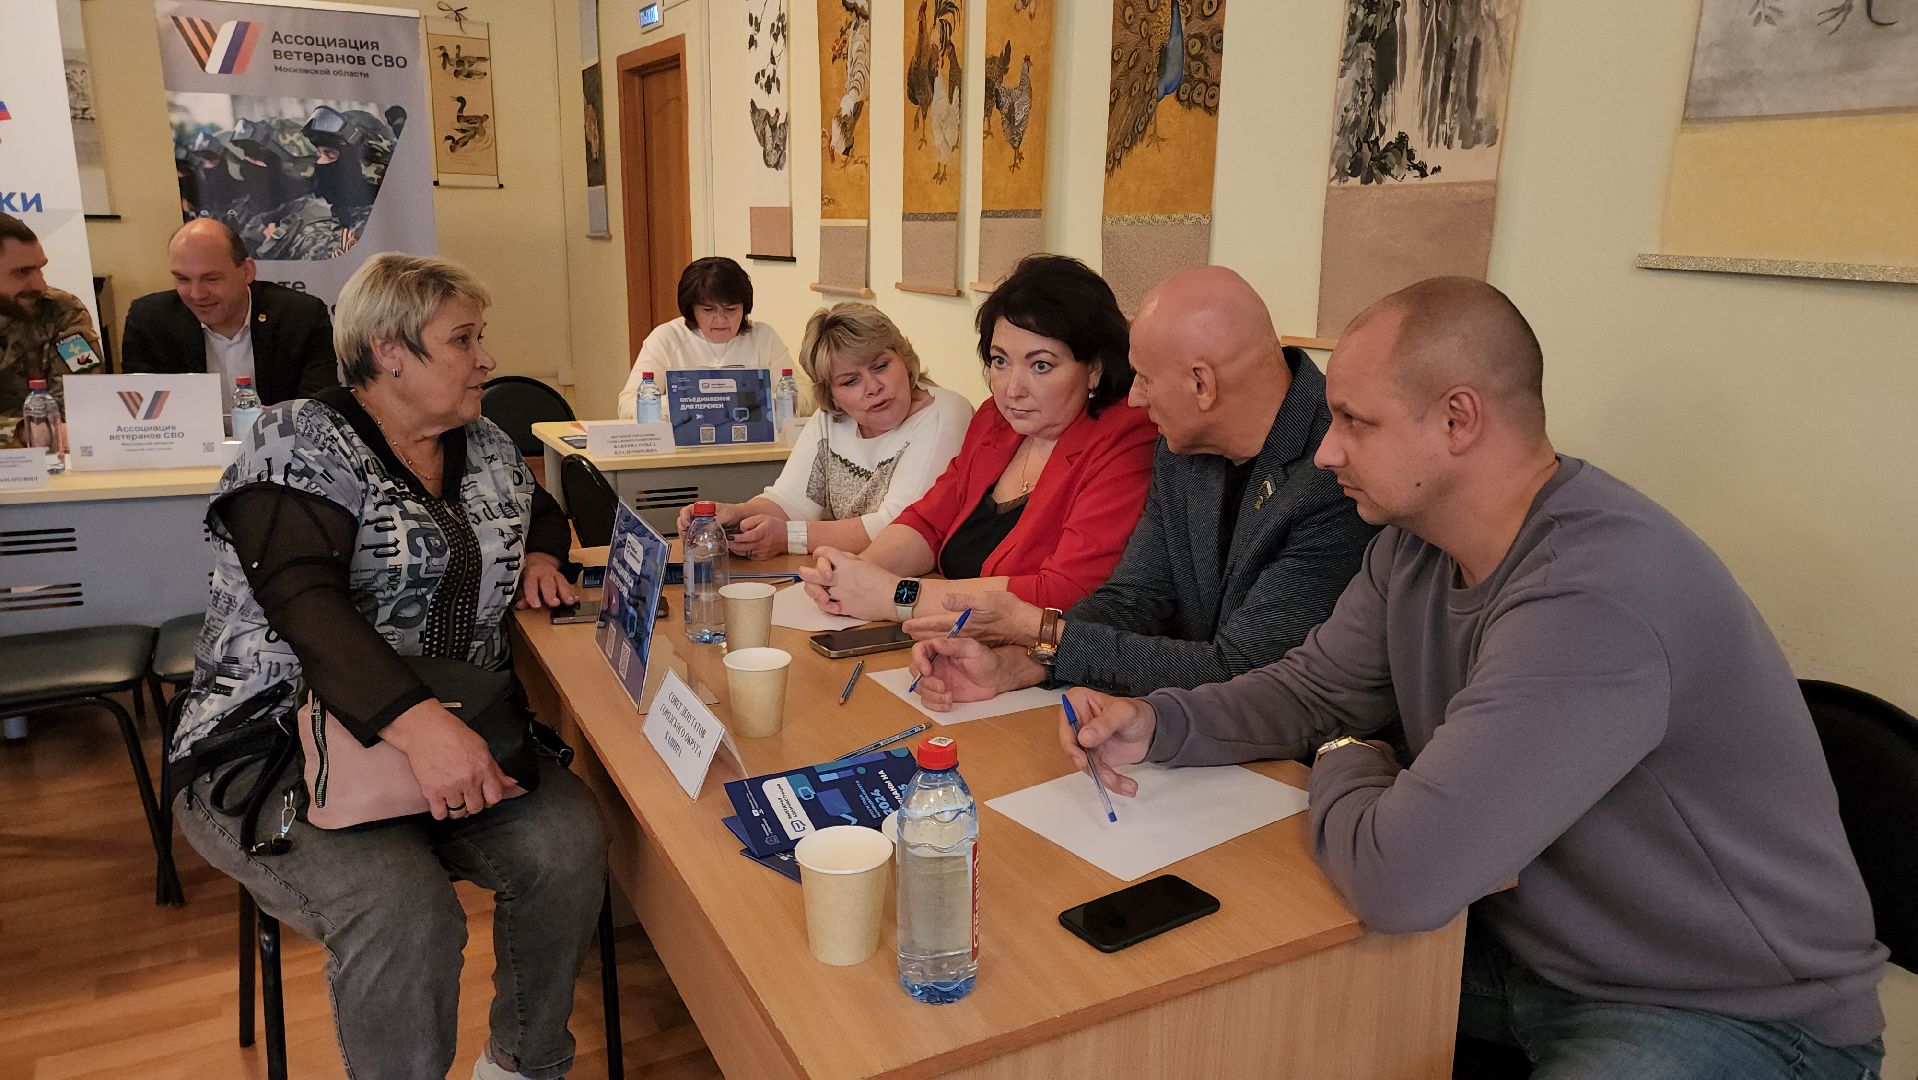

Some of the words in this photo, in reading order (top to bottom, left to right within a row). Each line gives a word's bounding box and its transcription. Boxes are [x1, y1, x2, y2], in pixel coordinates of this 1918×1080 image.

[271, 31, 380, 51] Ассоциация
[272, 49, 367, 66] ветеранов
[371, 54, 408, 69] СВО
[274, 65, 331, 76] Московской
[333, 70, 370, 79] области
[109, 433, 161, 441] ветеранов
[163, 432, 185, 440] СВО
[116, 425, 176, 434] Ассоциация
[878, 769, 888, 781] НА
[884, 780, 903, 804] ПЛАНЫ
[870, 788, 895, 815] 2024
